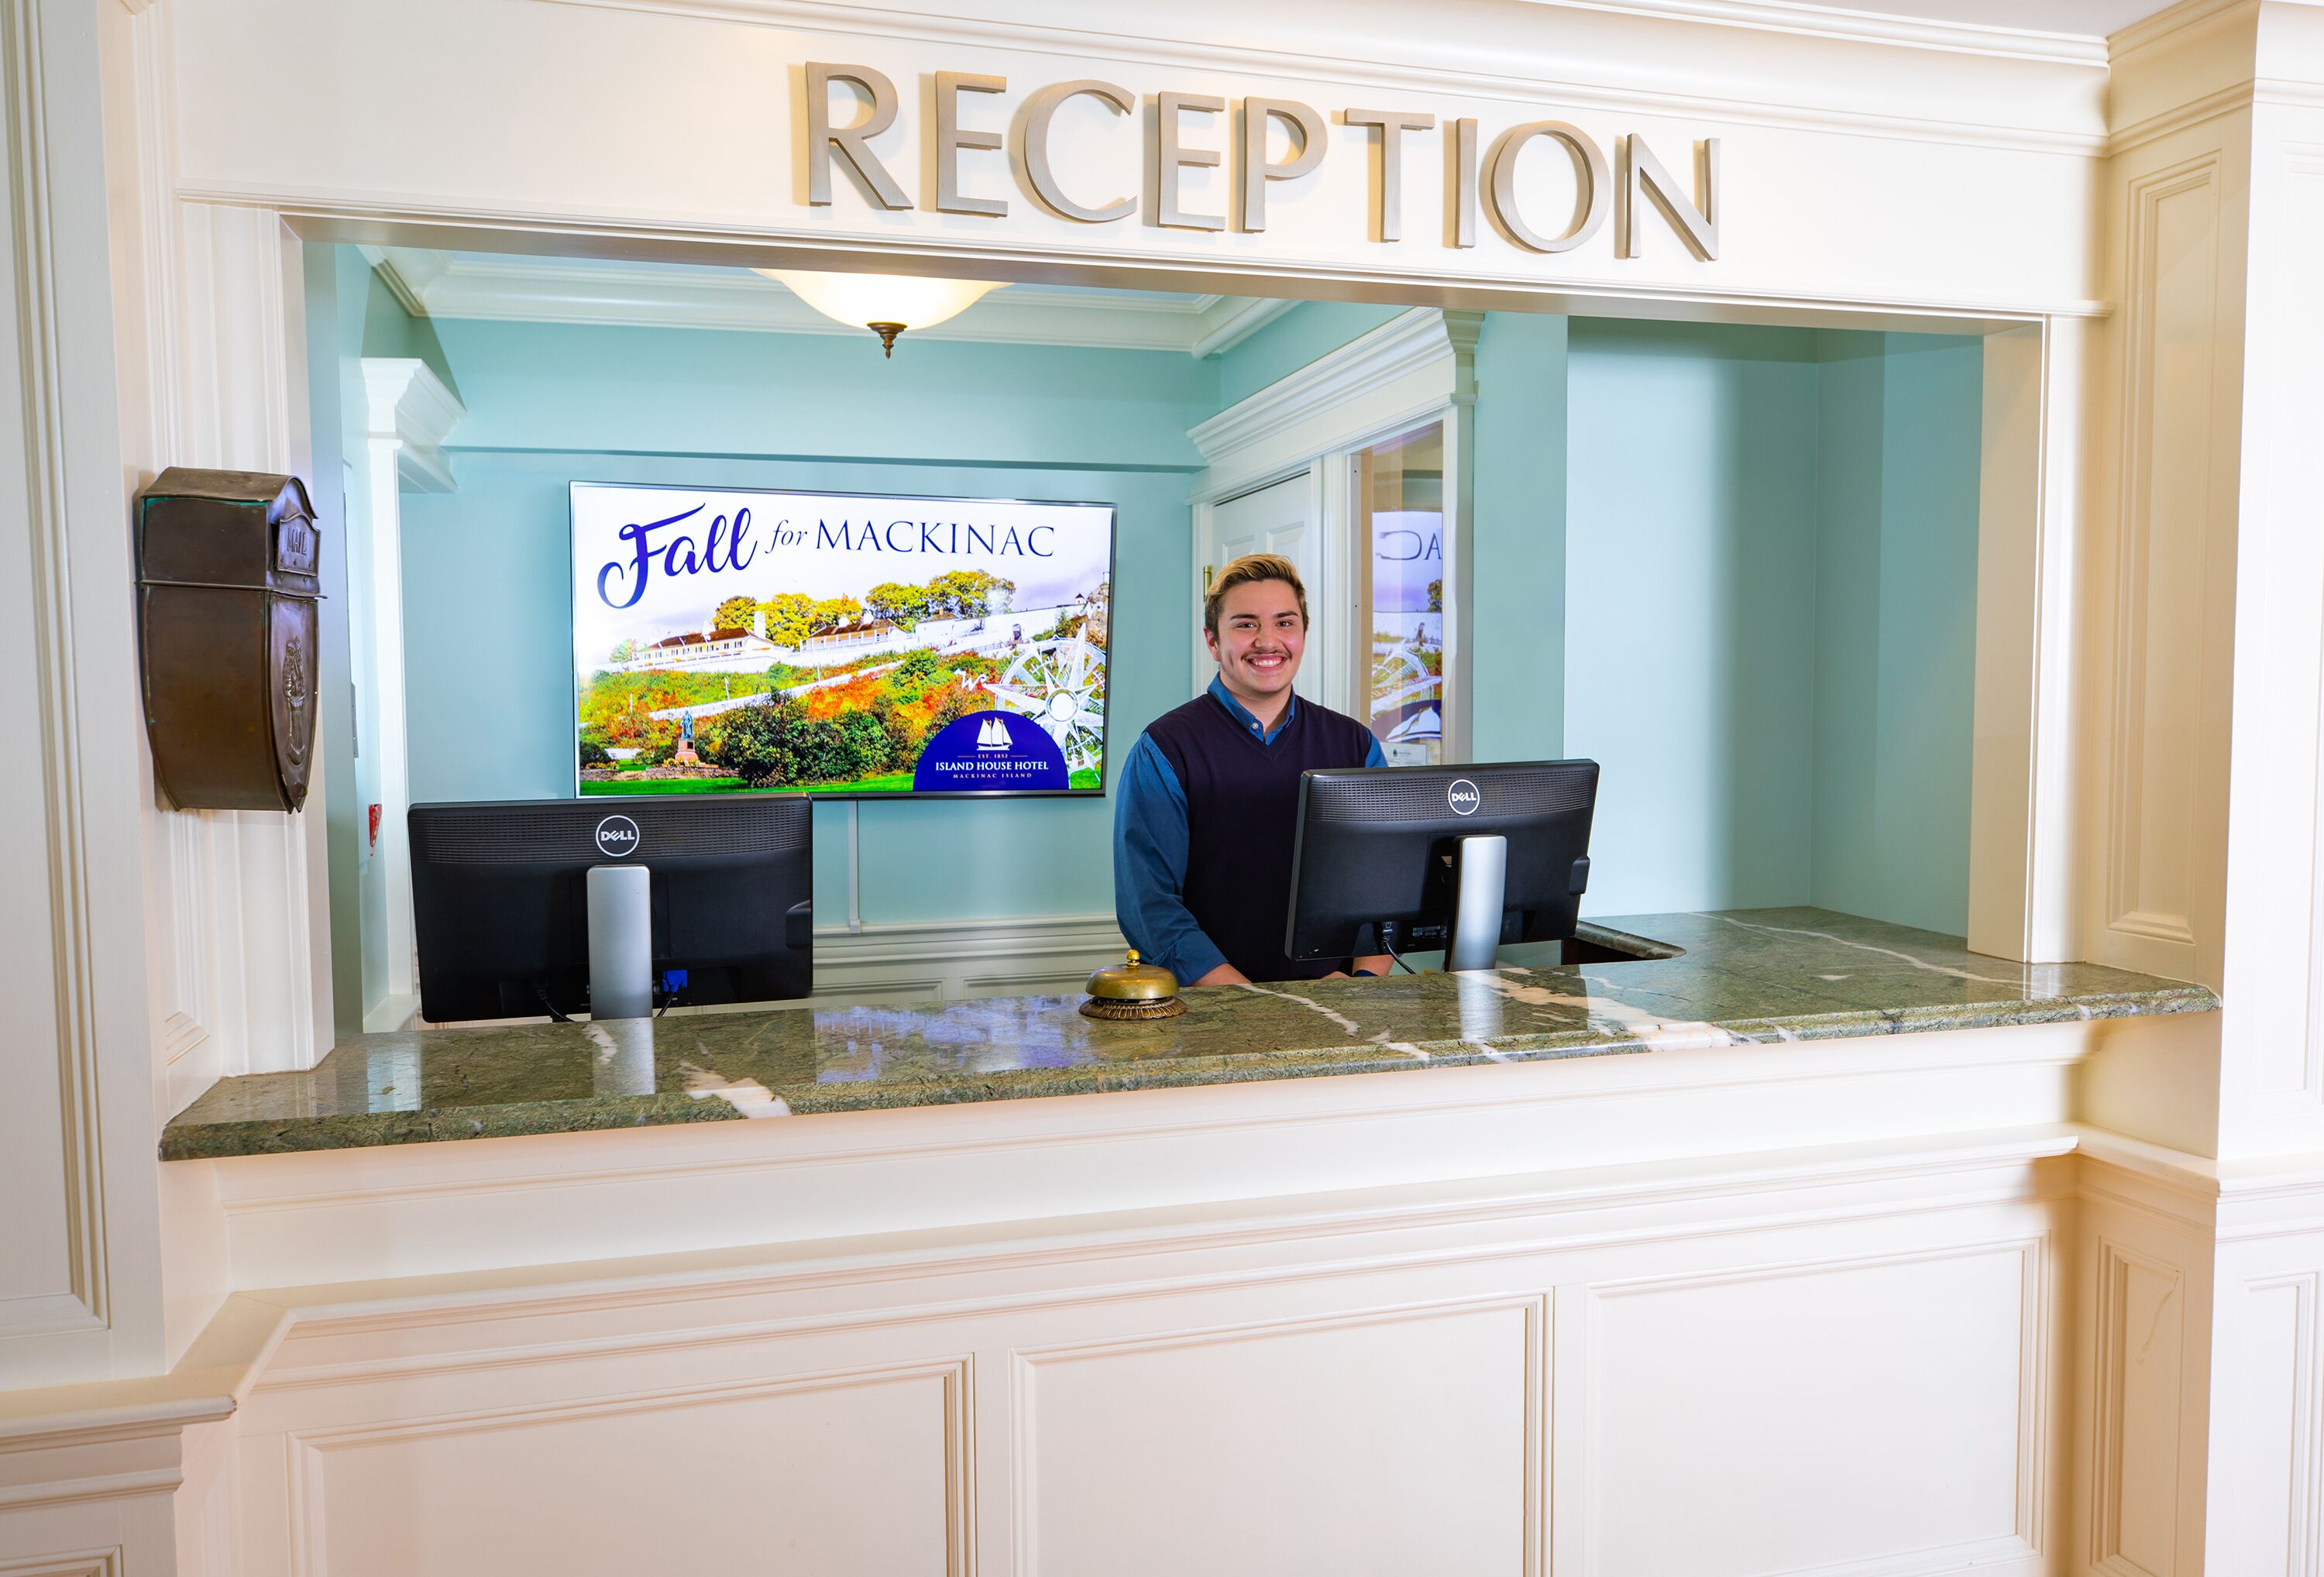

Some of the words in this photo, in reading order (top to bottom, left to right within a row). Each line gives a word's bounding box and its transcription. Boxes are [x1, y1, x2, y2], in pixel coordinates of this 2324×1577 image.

[806, 60, 1721, 261] RECEPTION
[287, 527, 308, 556] MAIL
[596, 502, 758, 610] Fall
[764, 519, 808, 555] for
[815, 518, 1054, 558] MACKINAC
[935, 761, 975, 771] ISLAND
[976, 761, 1012, 771] HOUSE
[1014, 761, 1049, 770] HOTEL
[1451, 792, 1477, 802] DELL
[600, 830, 635, 841] DELL
